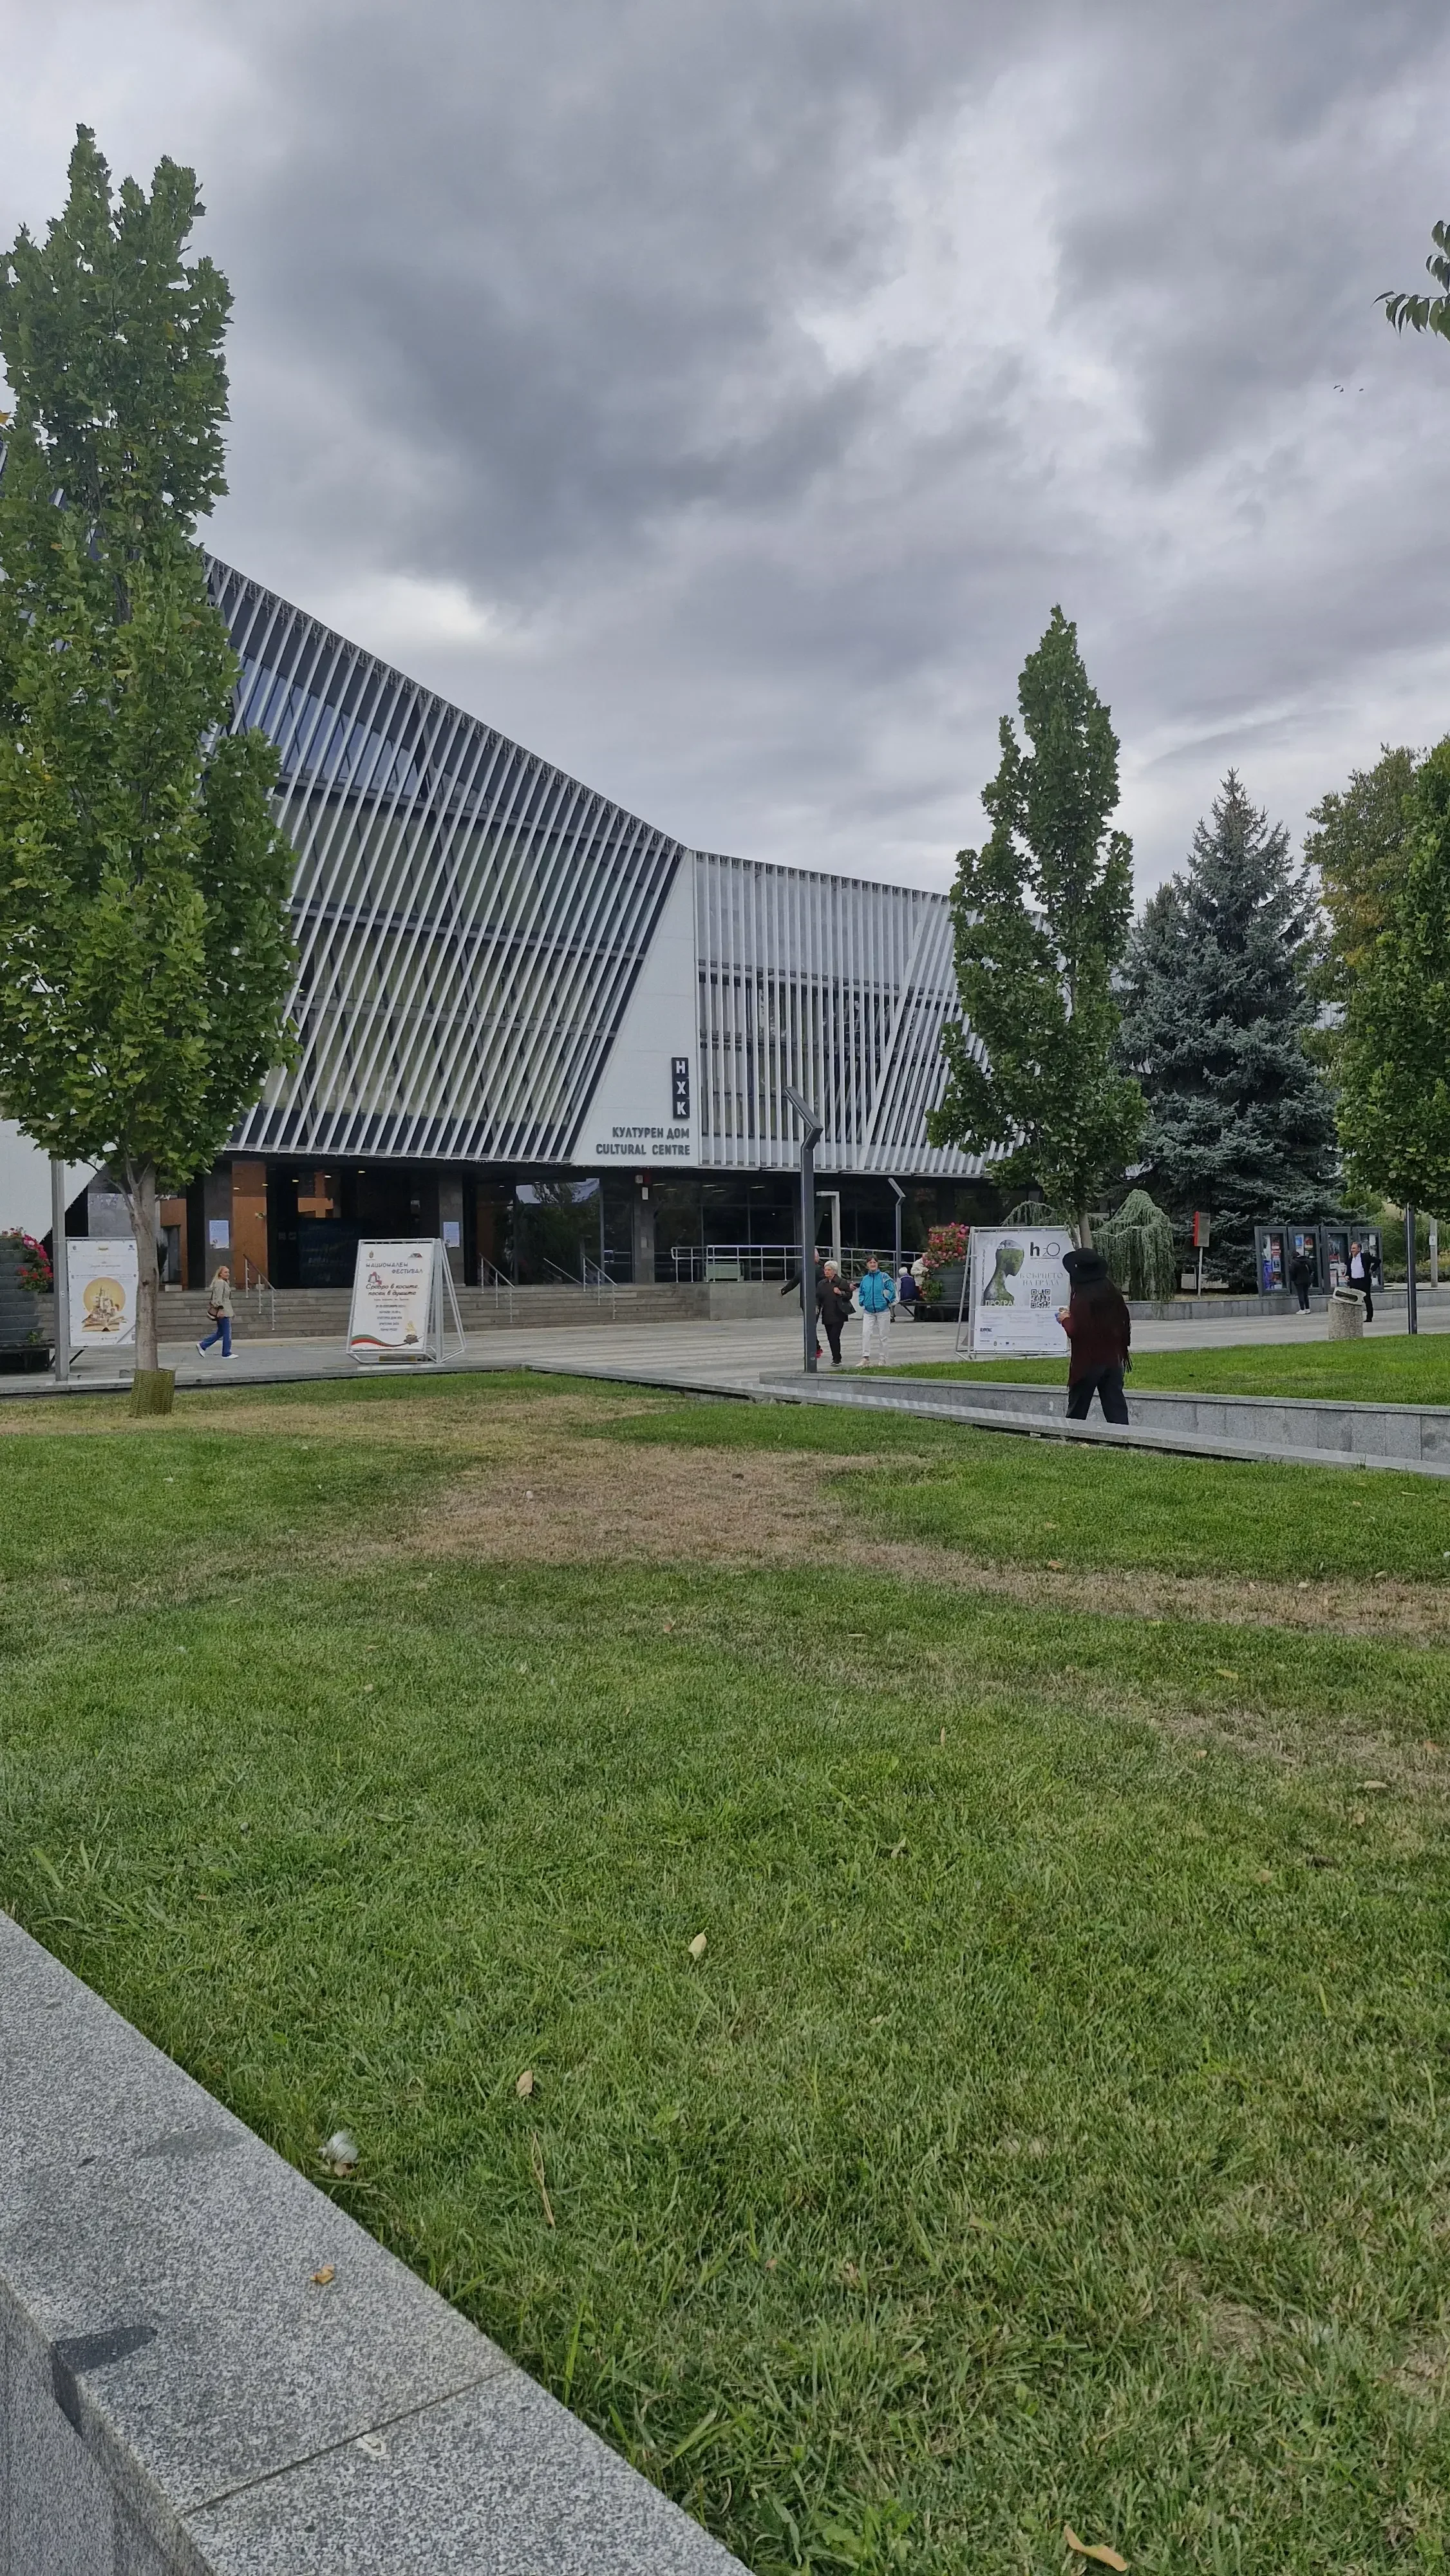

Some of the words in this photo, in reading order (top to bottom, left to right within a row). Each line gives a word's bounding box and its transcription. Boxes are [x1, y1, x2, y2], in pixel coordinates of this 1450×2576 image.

[676, 1061, 687, 1115] НХК
[612, 1126, 664, 1138] КУЛТУРЕН
[666, 1128, 690, 1140] ДОМ
[596, 1144, 647, 1155] CULTURAL
[652, 1144, 690, 1155] CENTRE
